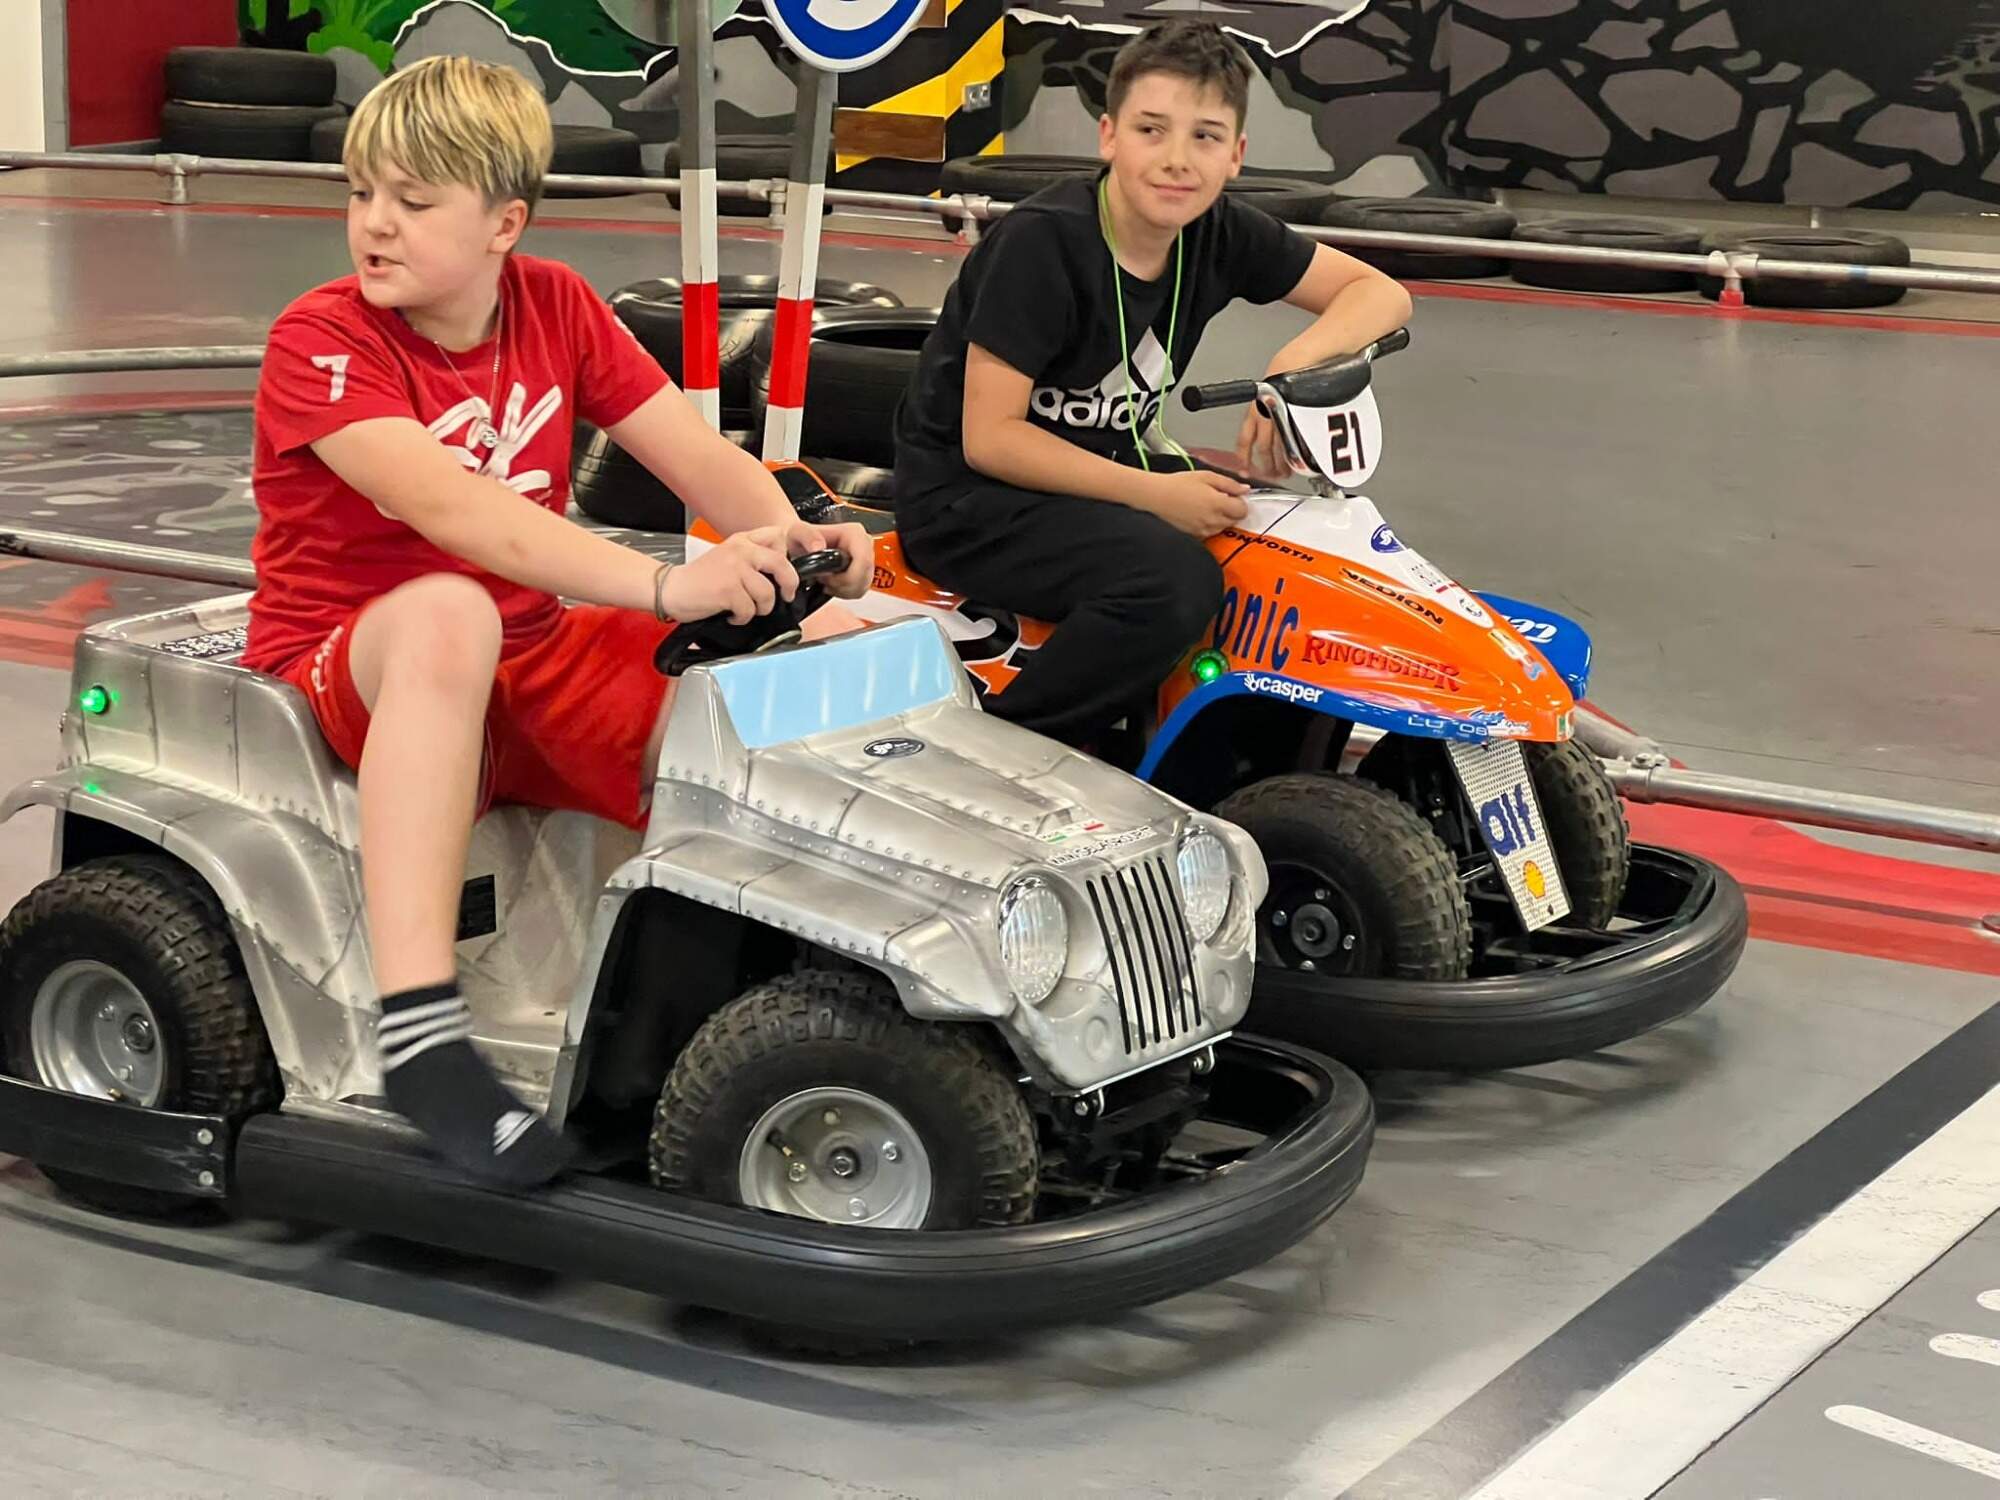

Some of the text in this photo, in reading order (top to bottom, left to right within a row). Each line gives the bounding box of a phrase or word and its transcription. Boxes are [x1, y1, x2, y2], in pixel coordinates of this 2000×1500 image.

[311, 354, 351, 403] 7
[1327, 410, 1366, 475] 21
[1259, 677, 1324, 703] casper
